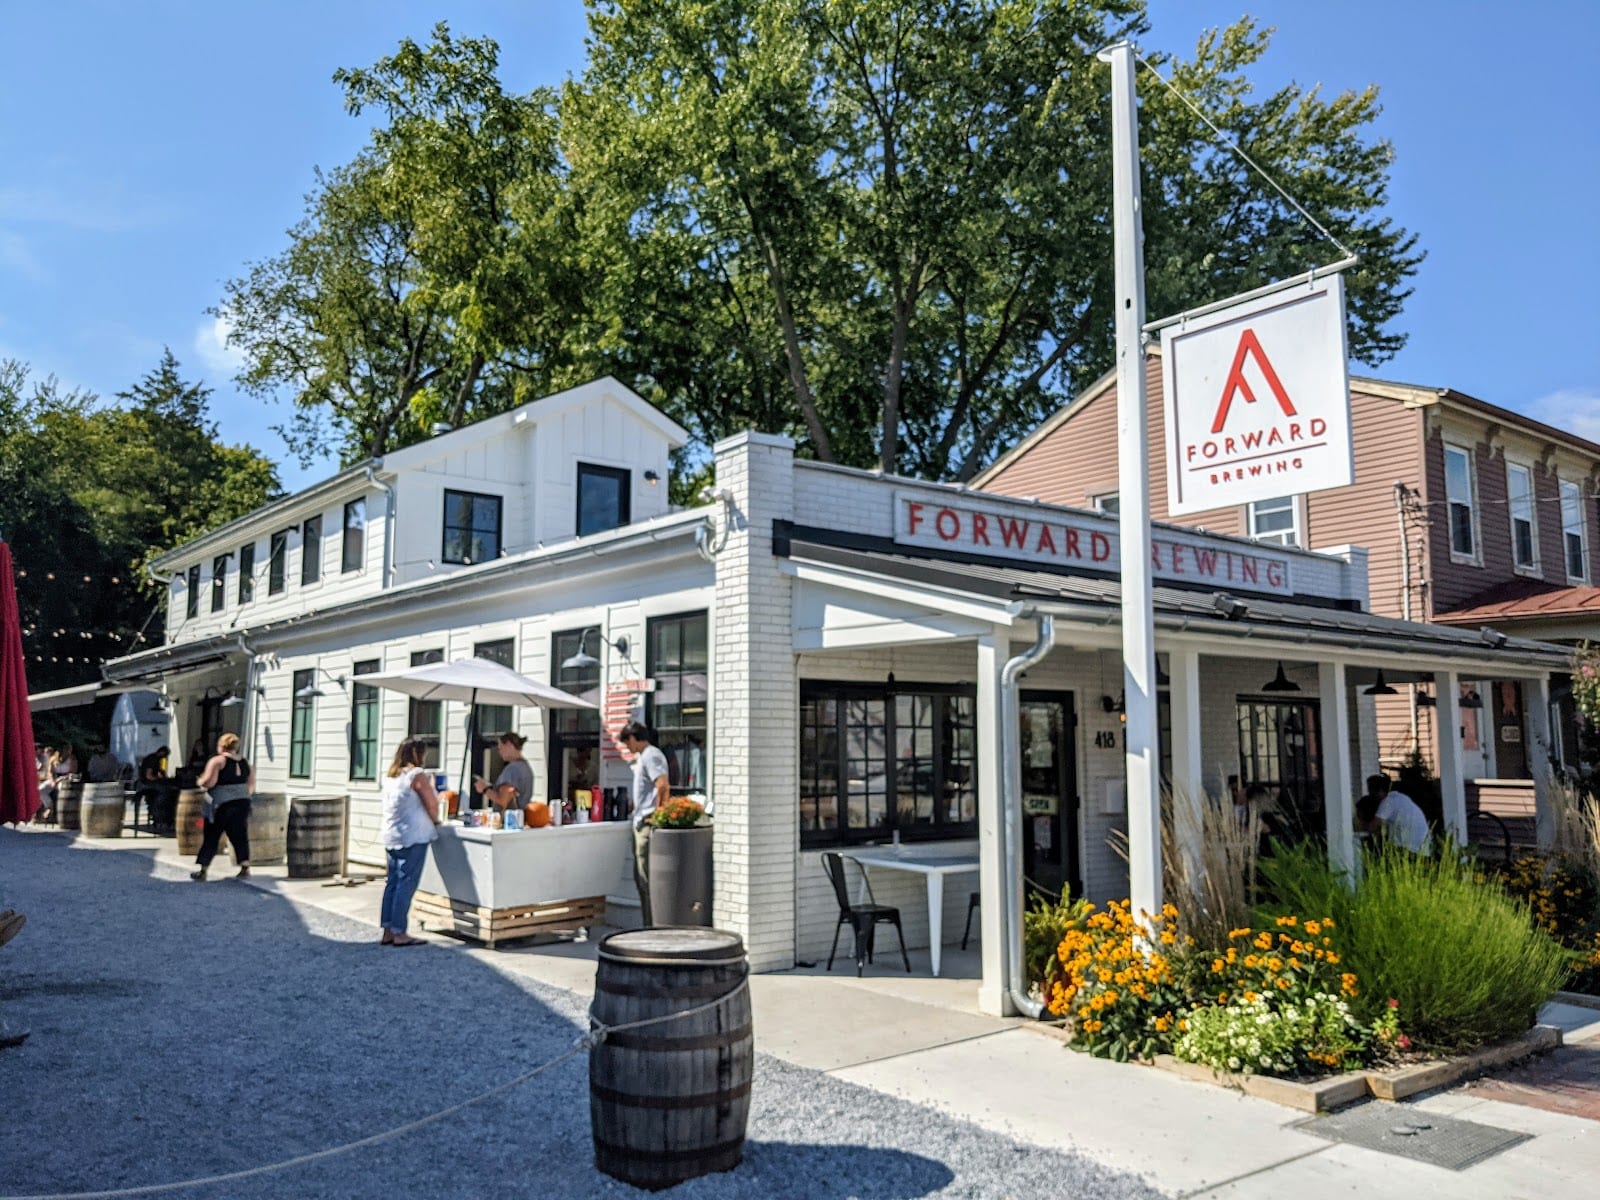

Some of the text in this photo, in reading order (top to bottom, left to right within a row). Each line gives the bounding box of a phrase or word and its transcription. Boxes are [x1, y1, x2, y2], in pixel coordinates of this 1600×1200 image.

[1186, 418, 1327, 462] FORWARD
[1210, 458, 1302, 484] BREWING
[909, 503, 1282, 587] FORWARD REWING
[1095, 731, 1115, 749] 418
